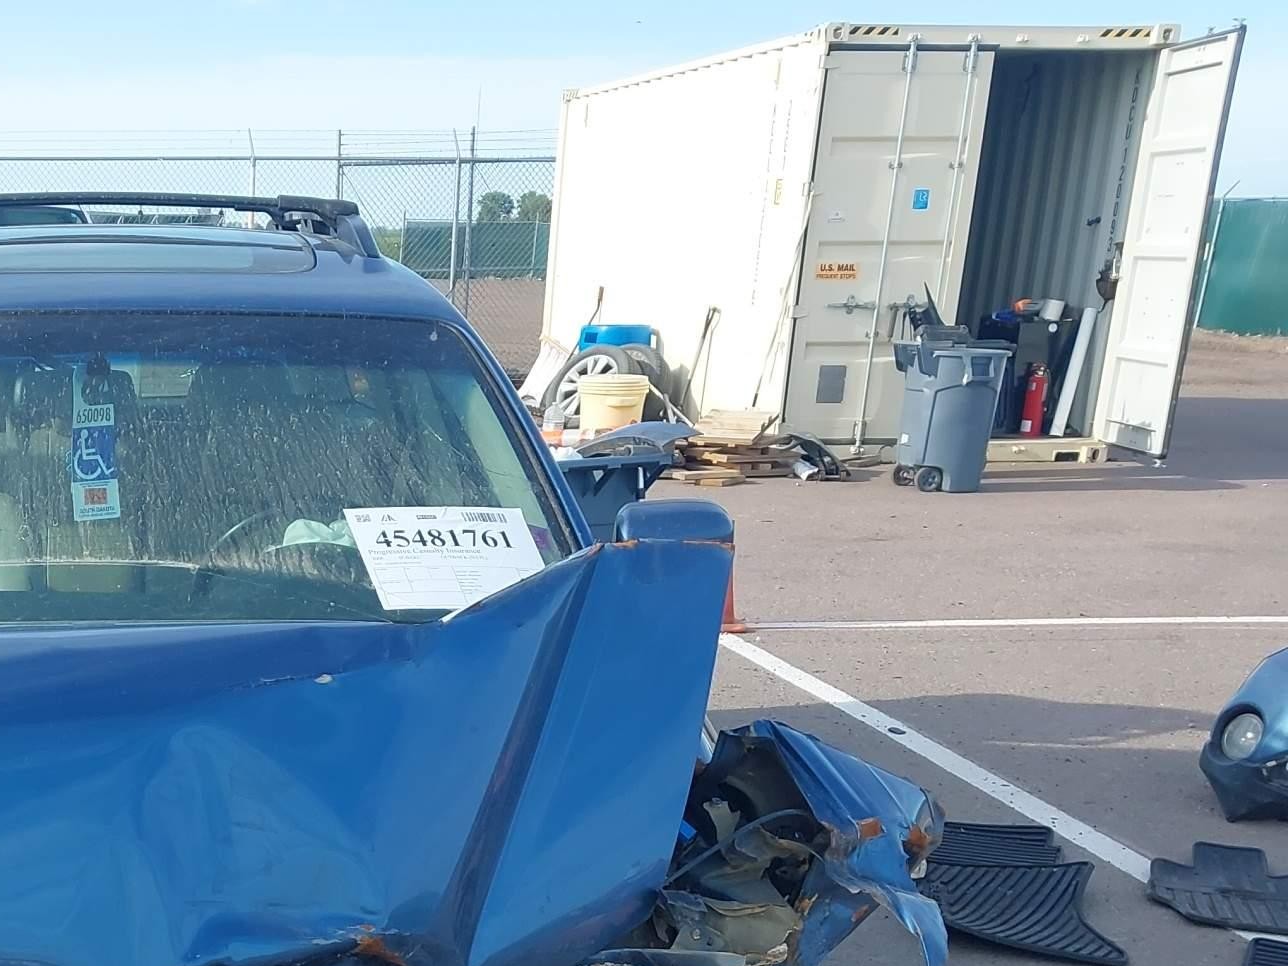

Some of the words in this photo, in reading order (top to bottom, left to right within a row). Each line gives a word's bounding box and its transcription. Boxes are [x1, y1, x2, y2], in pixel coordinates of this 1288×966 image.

[820, 264, 835, 272] U.S.
[837, 263, 856, 272] MAIL
[76, 407, 111, 424] 650098
[375, 528, 518, 549] 45481761
